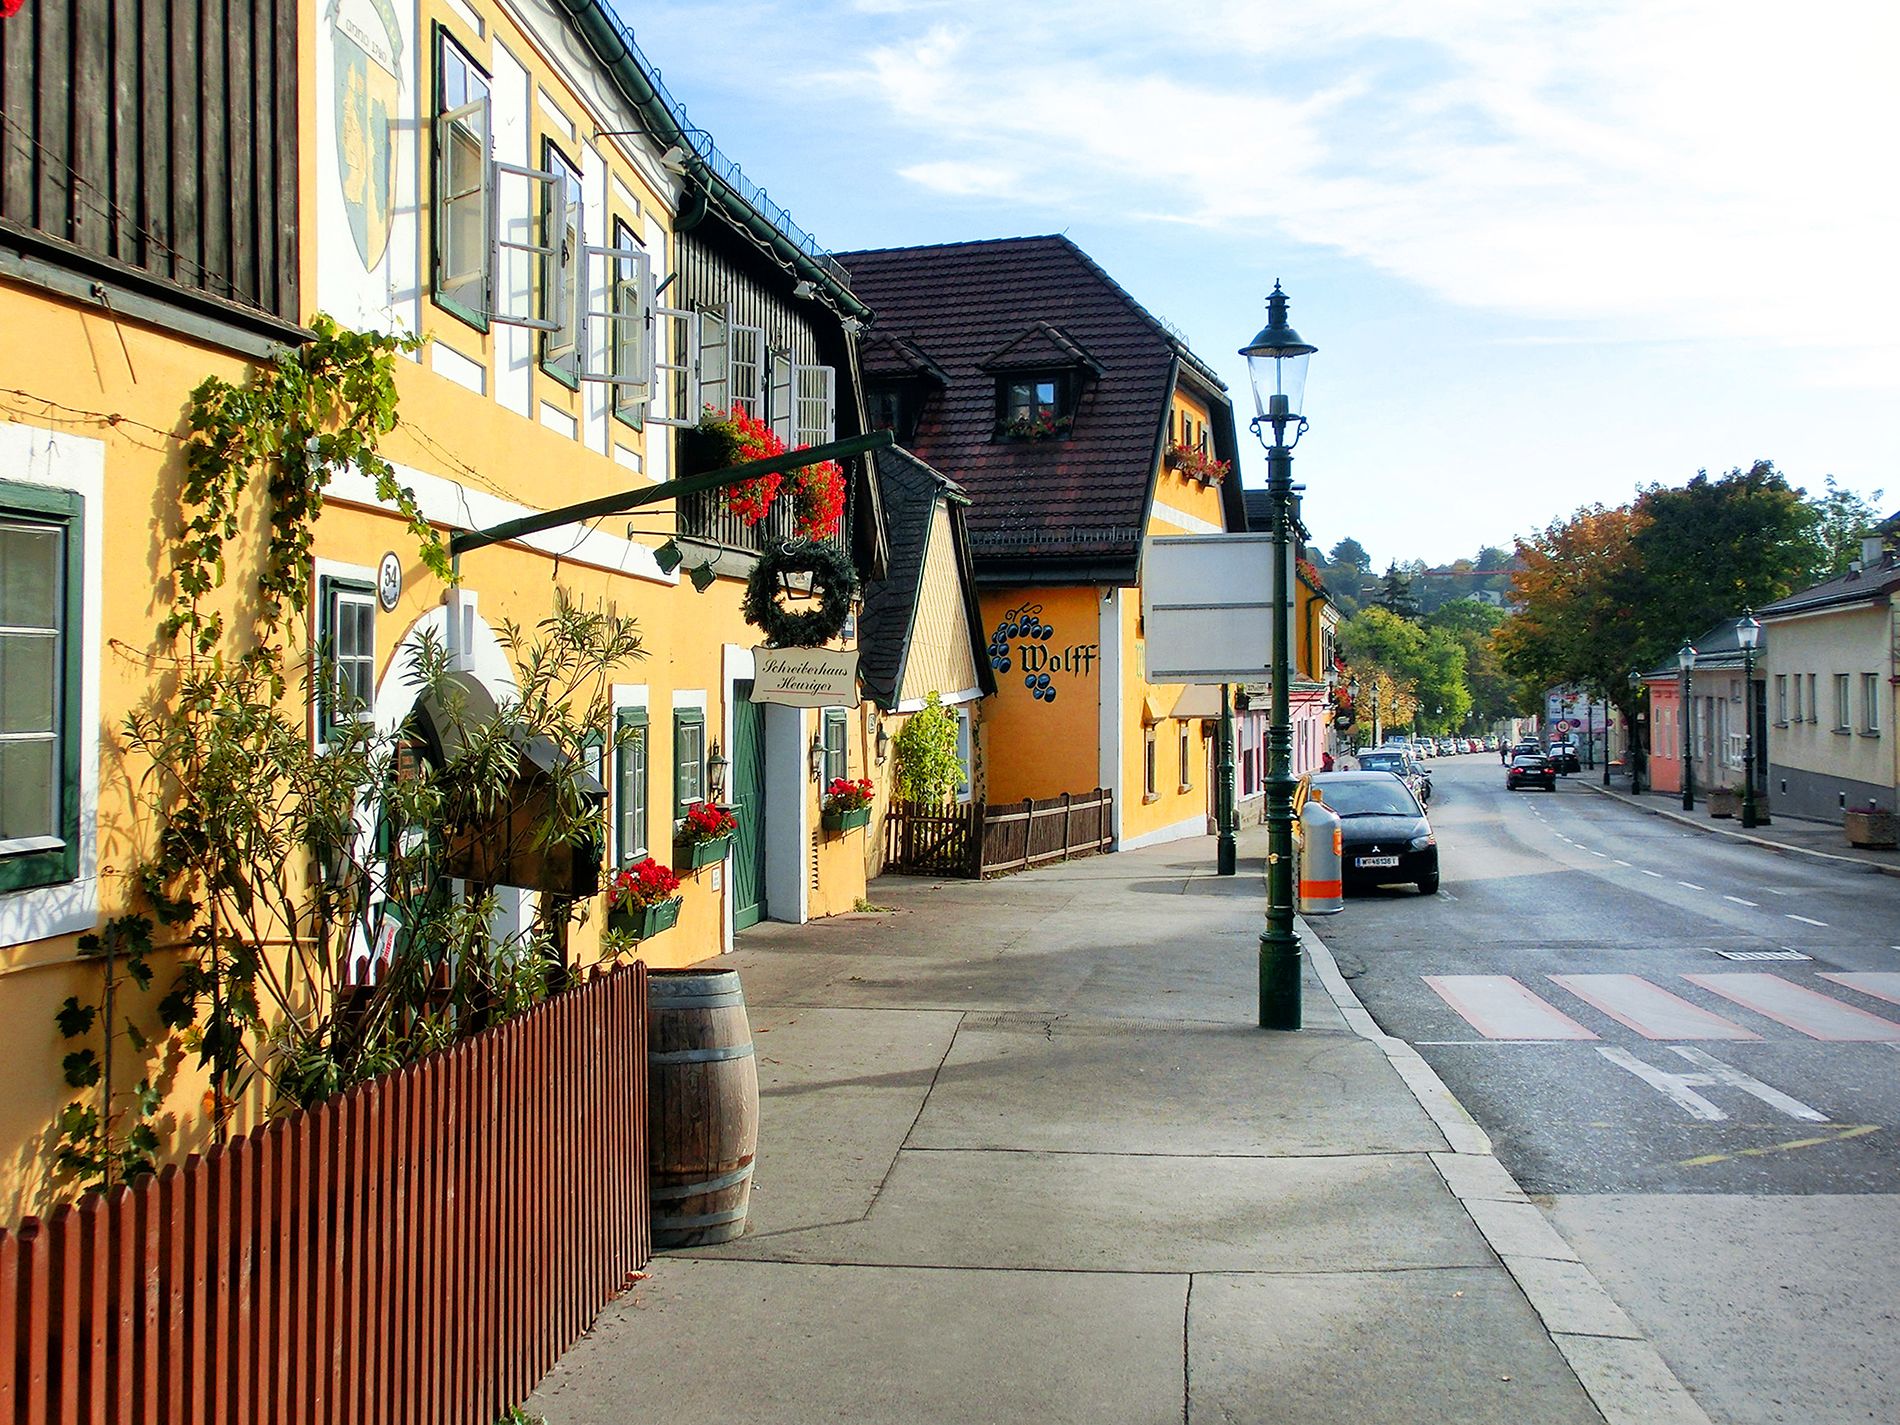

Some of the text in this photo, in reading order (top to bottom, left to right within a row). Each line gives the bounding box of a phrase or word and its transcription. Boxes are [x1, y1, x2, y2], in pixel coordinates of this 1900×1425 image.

[385, 564, 397, 588] 54
[762, 660, 848, 676] Schreiberhaus
[1017, 644, 1098, 678] Wolff
[777, 676, 832, 696] Heuriger
